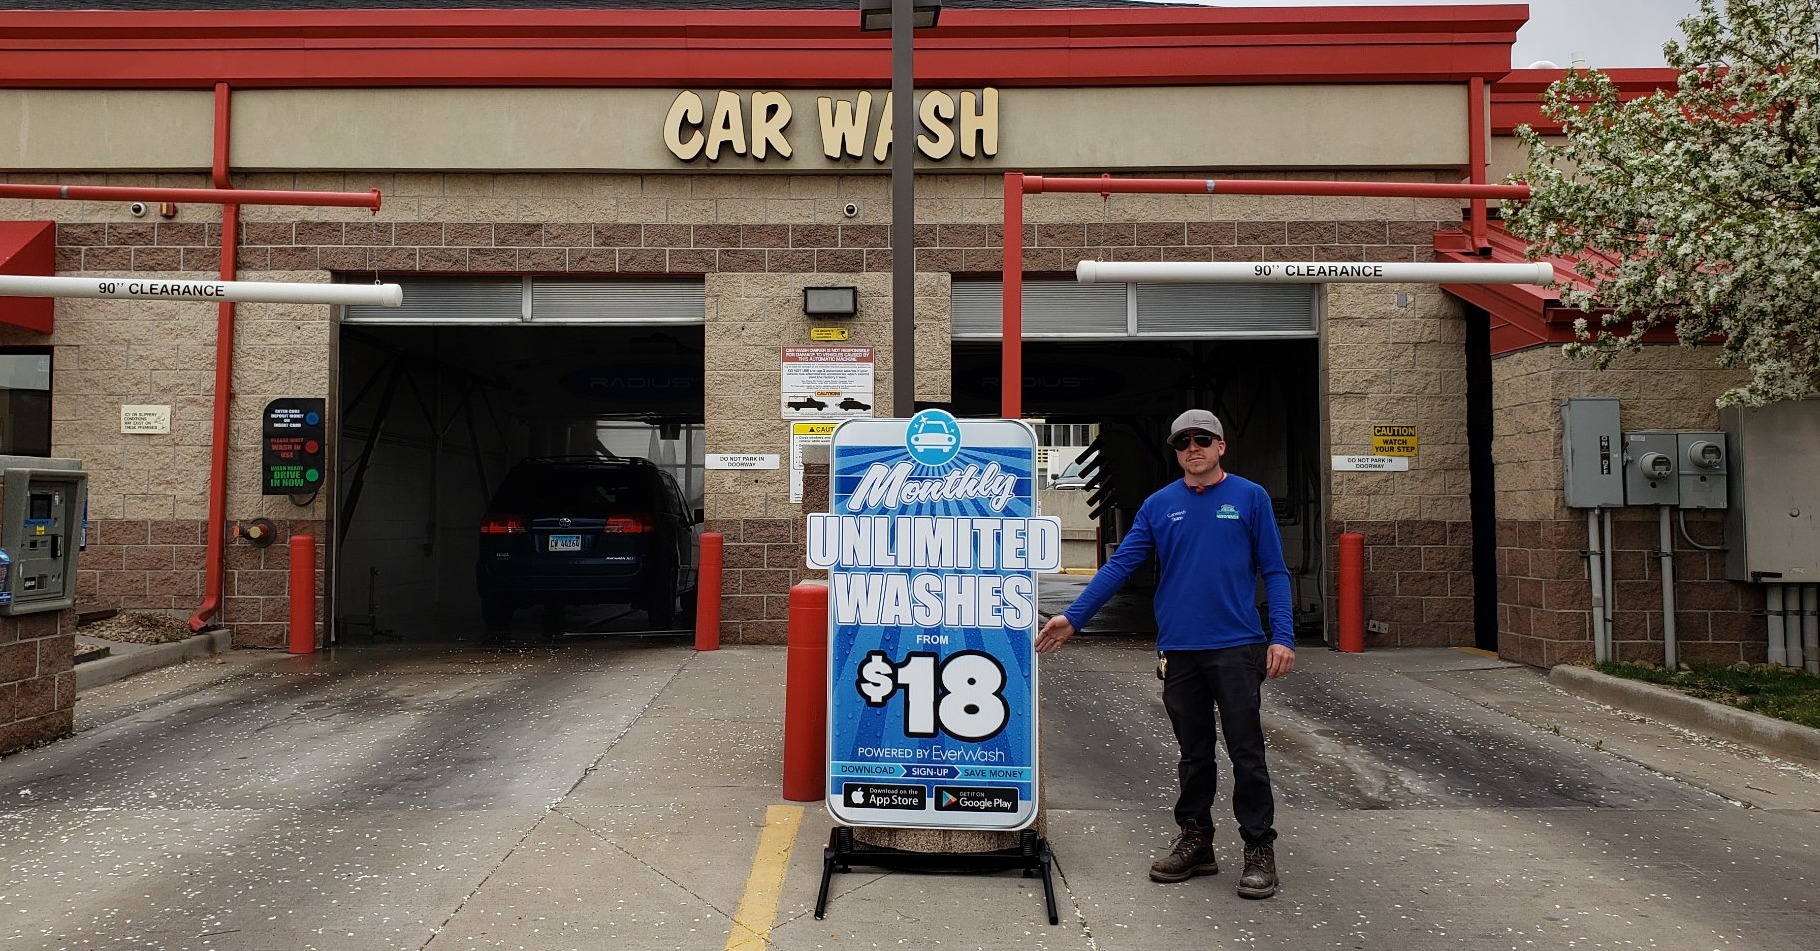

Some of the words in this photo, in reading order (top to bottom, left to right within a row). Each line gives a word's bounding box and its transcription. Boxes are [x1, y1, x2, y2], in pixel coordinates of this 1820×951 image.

[663, 90, 793, 162] CAR
[1285, 265, 1382, 277] CLEARANCE
[129, 283, 225, 296] CLEARANCE
[982, 377, 1080, 388] RDIUS
[1374, 427, 1415, 435] CAUTION
[848, 462, 1017, 512] Monthly
[809, 516, 1060, 571] UNLIMITED
[833, 573, 1034, 629] WASHES
[916, 635, 949, 645] FROM
[855, 650, 1010, 743] $18
[858, 748, 912, 758] POWERED
[917, 749, 930, 759] BY
[933, 746, 1005, 762] EverWash
[842, 765, 895, 775] DOWNLOAD
[912, 768, 948, 776] SIGN-UP
[989, 770, 1024, 778] MONEY
[869, 795, 890, 805] App
[892, 795, 919, 805] Store
[960, 797, 992, 809] Google
[994, 798, 1012, 809] Play
